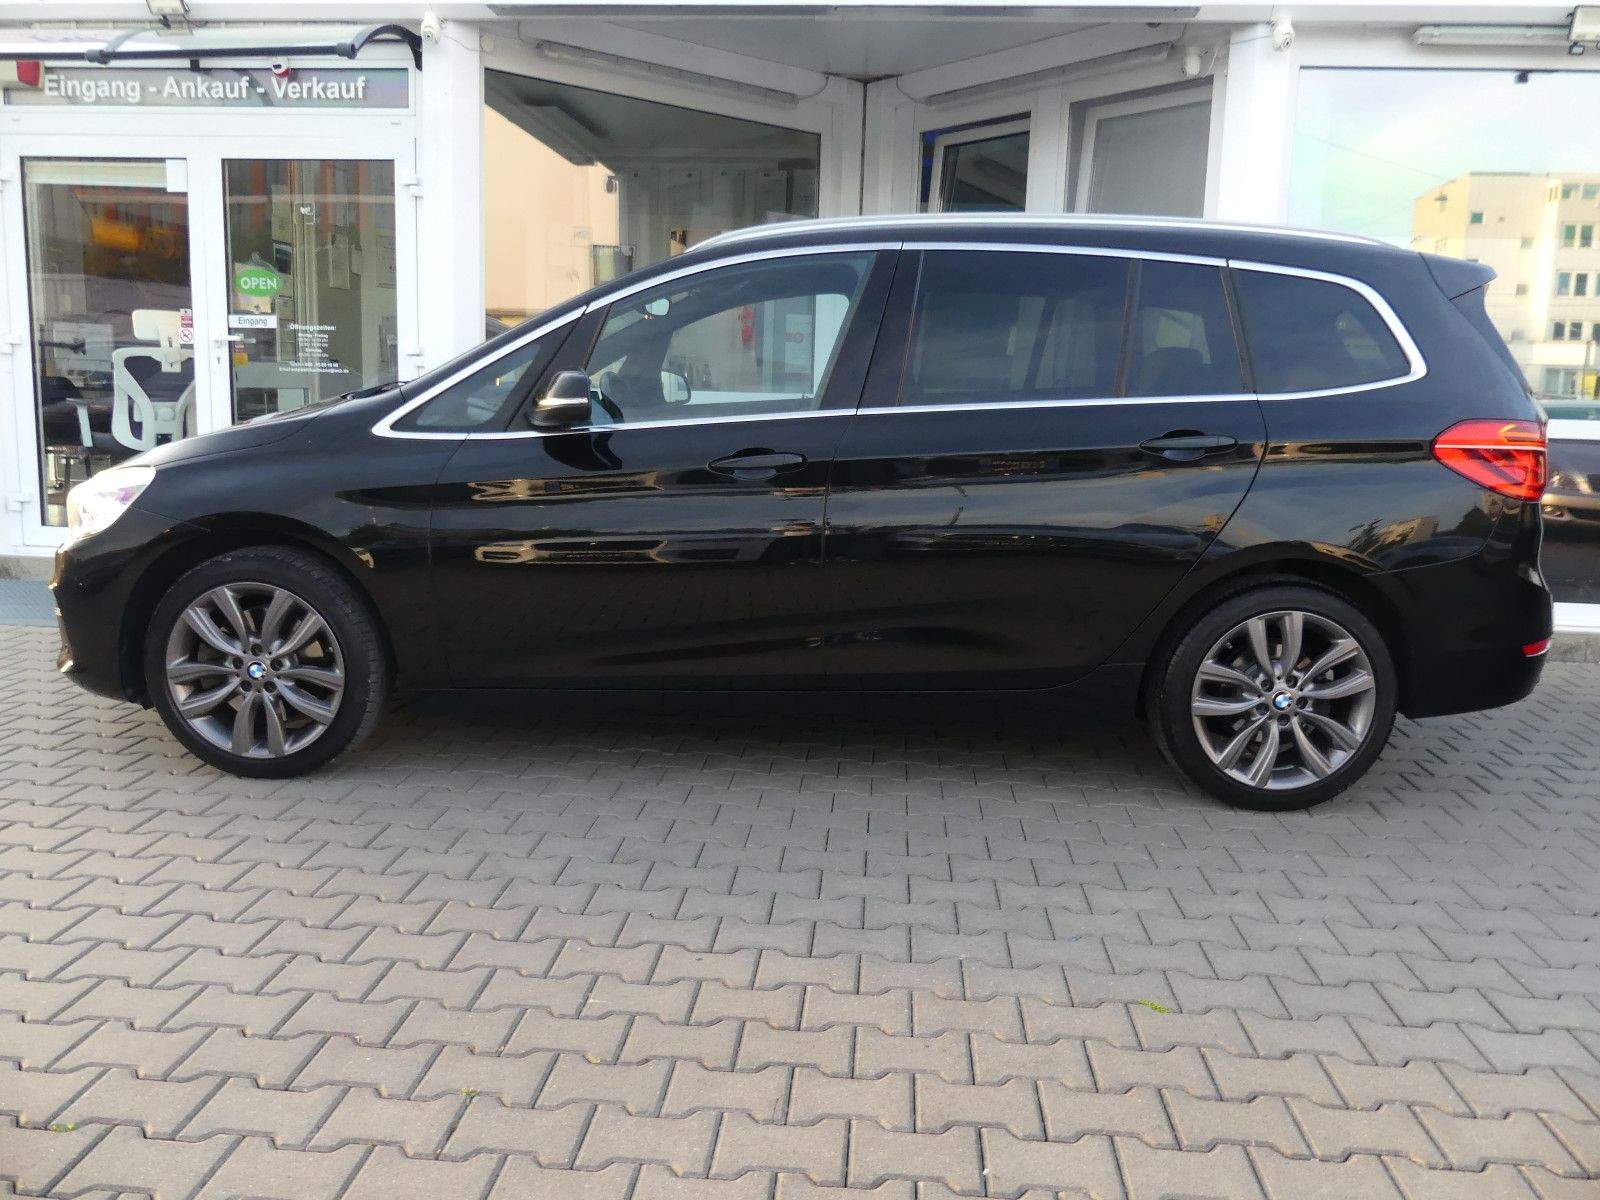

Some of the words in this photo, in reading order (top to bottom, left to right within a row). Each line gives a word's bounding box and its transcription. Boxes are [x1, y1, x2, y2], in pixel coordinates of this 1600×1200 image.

[44, 74, 141, 103] Eingang
[163, 75, 250, 99] Ankauf
[271, 76, 366, 99] Verkauf
[240, 276, 278, 290] OPEN
[238, 316, 268, 327] Eingang
